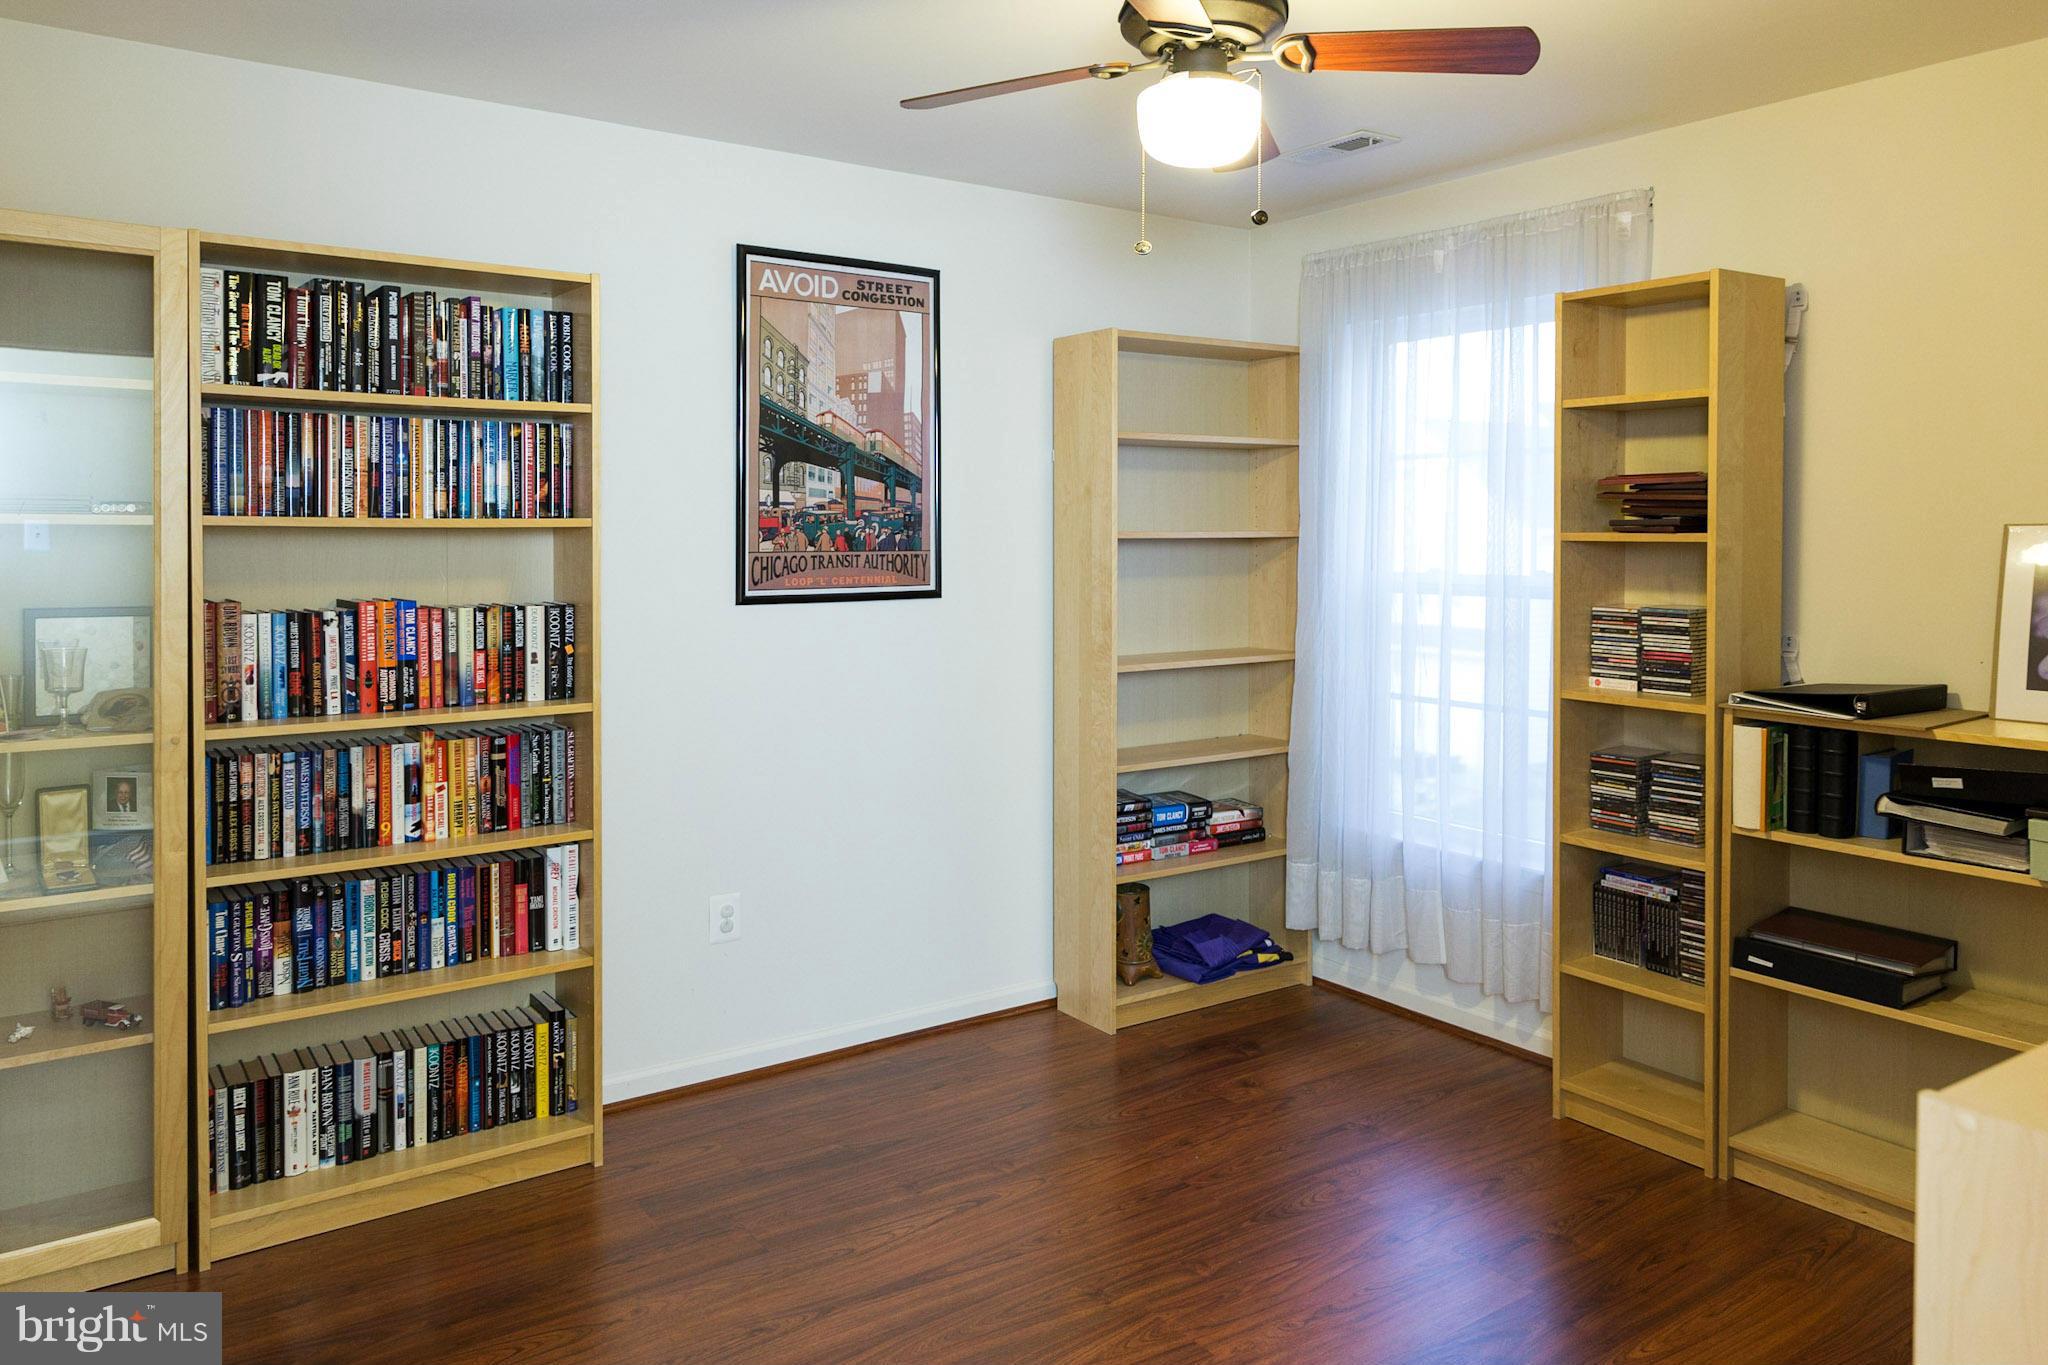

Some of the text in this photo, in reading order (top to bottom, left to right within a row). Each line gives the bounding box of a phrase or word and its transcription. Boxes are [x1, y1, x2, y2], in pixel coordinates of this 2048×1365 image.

[227, 274, 240, 290] The
[758, 268, 839, 299] AVOID
[842, 290, 924, 307] CONGESTION
[856, 279, 912, 295] STREET
[240, 303, 251, 320] Tom
[266, 281, 282, 343] TOM CLANCY
[293, 294, 310, 350] Tom Clancy
[388, 291, 398, 340] POWER HOUSE
[227, 330, 240, 346] The
[549, 315, 558, 372] ROBIN COOK
[562, 314, 571, 373] ROBIN COOK
[751, 553, 928, 586] CHICAGO TRANSIT AUTHORITY
[784, 577, 814, 587] LOOP
[831, 574, 898, 585] CENTENNIAL
[223, 606, 239, 648] DAN BROWN
[384, 608, 396, 661] TOM CLANCY
[406, 608, 415, 656] TOM CLANCY
[550, 610, 560, 649] KOONTZ
[565, 609, 574, 643] KOONTZ
[275, 628, 286, 665] KOONTZ
[420, 622, 429, 677] JAMES PATTERSON
[532, 749, 541, 775] Grafton
[284, 769, 295, 810] BEACH ROAD
[300, 757, 310, 829] JAMES PATTERSON
[381, 747, 391, 821] JAMES PATTERSON
[272, 778, 280, 842] JAMES PATTERSON
[551, 862, 560, 880] PREY
[233, 902, 242, 917] SUE
[392, 877, 401, 905] ROBIN
[213, 910, 228, 957] Tom Clancy
[245, 901, 254, 949] SPECIAL AGENT
[364, 895, 374, 934] ROBIN COOK
[379, 881, 391, 963] ROBIN COOK CRISIS
[392, 908, 401, 932] COOK
[447, 873, 456, 957] ROBIN COOK CRITICAL
[233, 917, 242, 952] GRAFTON
[230, 952, 243, 963] S
[429, 1048, 440, 1090] KOONTZ
[496, 1036, 507, 1074] KOONTZ
[511, 1034, 520, 1072] KOONTZ
[524, 1031, 535, 1070] KOONTZ
[233, 1087, 247, 1110] MERCY
[288, 1075, 301, 1106] ANN RULE
[321, 1069, 334, 1127] DAN BROWN
[338, 1075, 352, 1122] DAN BROWN
[320, 1133, 328, 1151] POINT
